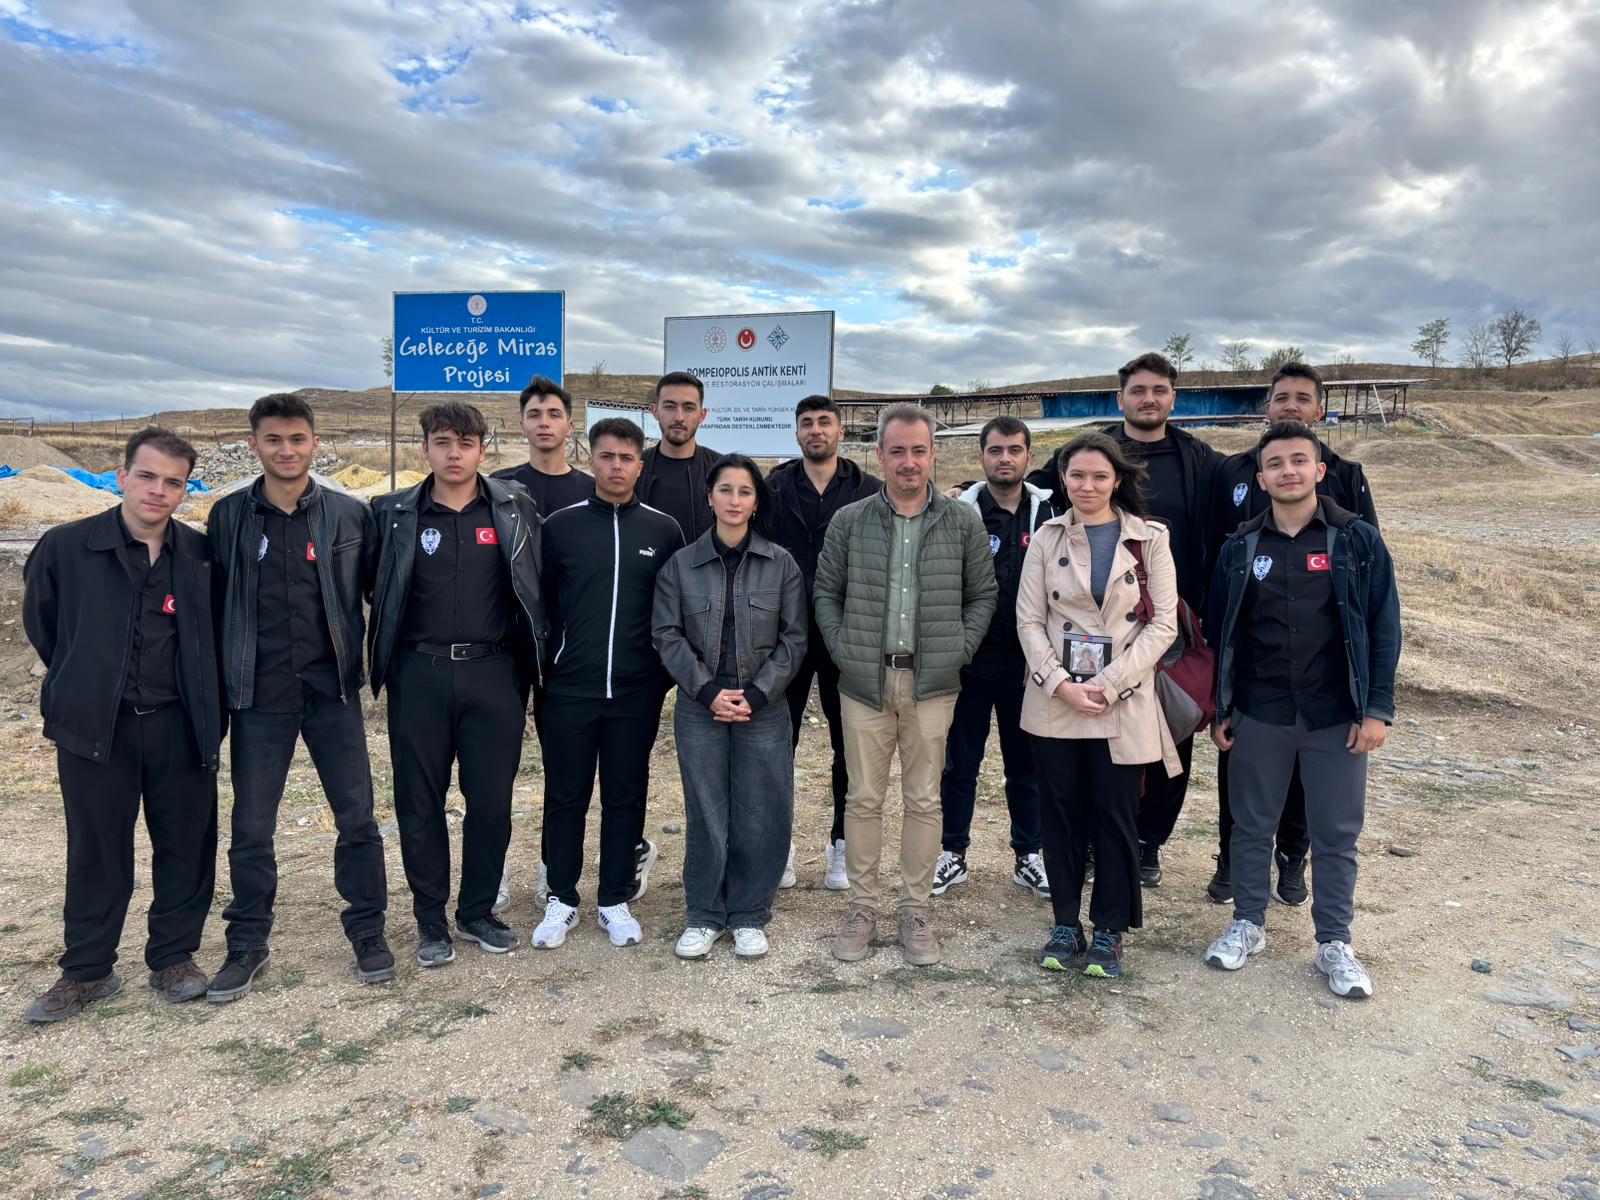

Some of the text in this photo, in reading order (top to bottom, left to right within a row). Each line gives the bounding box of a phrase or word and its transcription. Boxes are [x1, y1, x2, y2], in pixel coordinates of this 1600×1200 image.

[420, 326, 450, 334] KÜLTÜR
[451, 326, 462, 334] VE
[494, 325, 536, 333] BAKANLIĞI
[400, 336, 557, 363] Geleceğe Miras
[443, 366, 510, 388] Projesi
[751, 364, 778, 377] ANTİK
[780, 363, 806, 376] KENTİ
[711, 380, 760, 388] RESTORASYON
[761, 379, 807, 389] ÇALIŞMALARI
